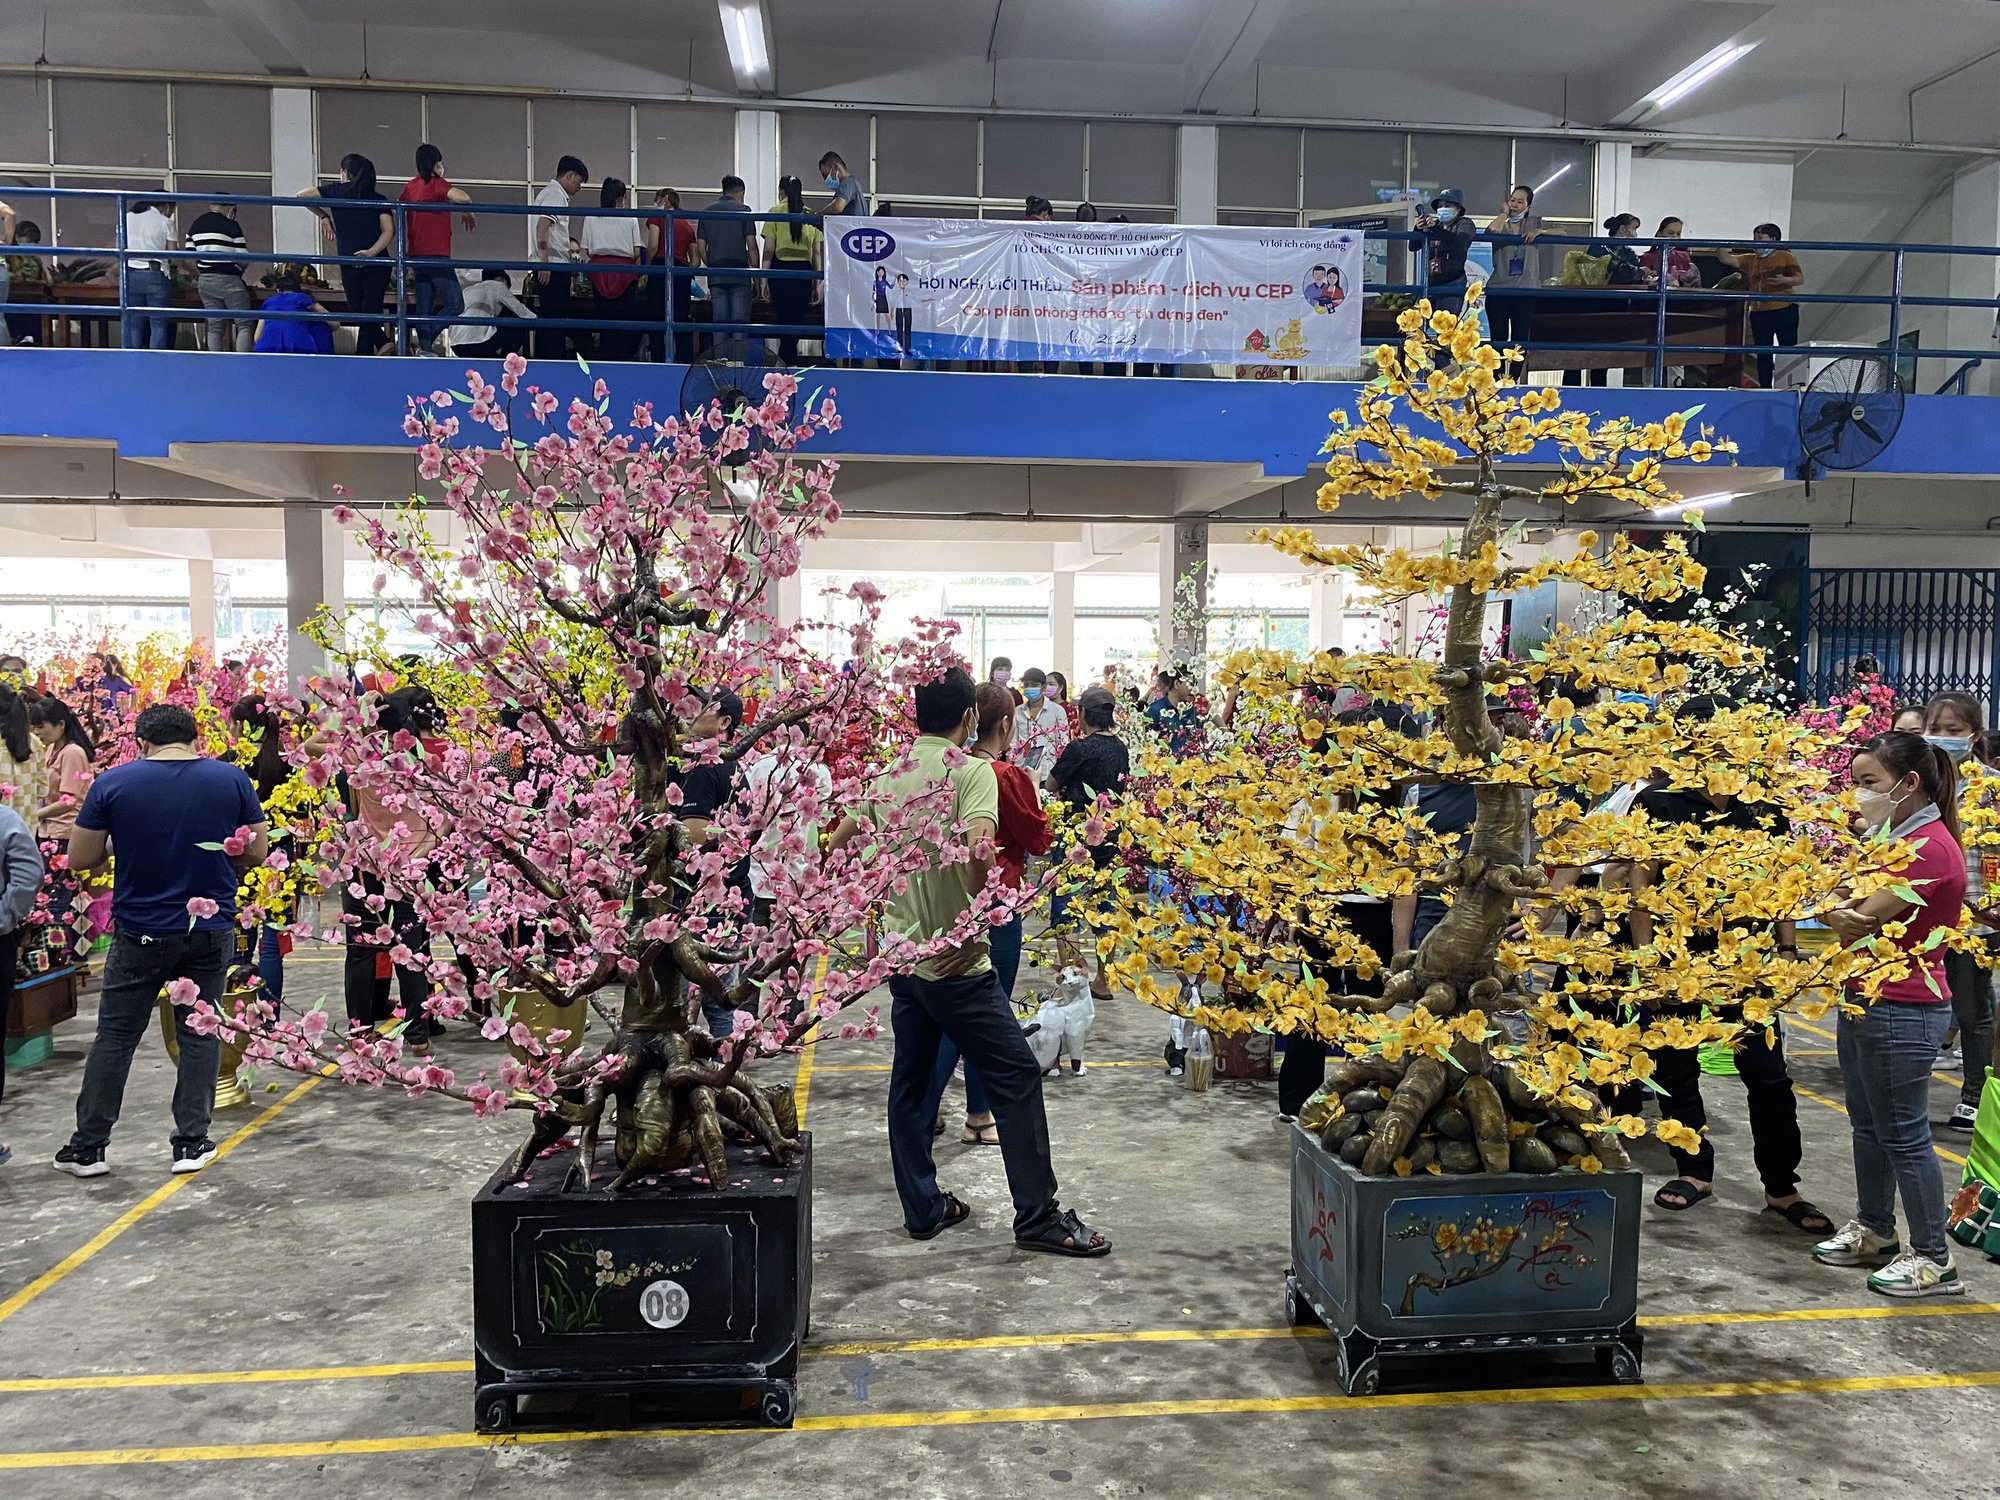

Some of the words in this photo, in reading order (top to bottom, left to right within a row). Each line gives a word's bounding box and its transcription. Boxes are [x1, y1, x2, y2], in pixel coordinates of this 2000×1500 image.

[1109, 233, 1120, 241] TP.
[1121, 231, 1133, 241] HỒ
[1134, 232, 1149, 241] CHÍ
[848, 235, 888, 254] CEP
[1013, 240, 1028, 254] TỔ
[1031, 243, 1064, 255] CHỨC
[1067, 243, 1084, 255] TÀI
[1086, 244, 1123, 256] CHÍNH
[1126, 247, 1137, 256] VI
[1140, 245, 1159, 257] MÔ
[1161, 247, 1183, 257] CEP
[1271, 239, 1283, 249] lợi
[1284, 239, 1298, 248] ích
[1299, 240, 1322, 252] cộng
[1323, 239, 1347, 253] đồng
[1112, 279, 1166, 298] phẩm
[1182, 281, 1222, 300] dịch
[1227, 285, 1250, 301] vụ
[1255, 283, 1294, 299] CEP
[994, 305, 1030, 319] phần
[1034, 305, 1078, 321] phòng
[1082, 306, 1126, 321] chống
[1197, 308, 1228, 321] đen"
[1096, 333, 1137, 346] 2023
[645, 1288, 684, 1322] 08
